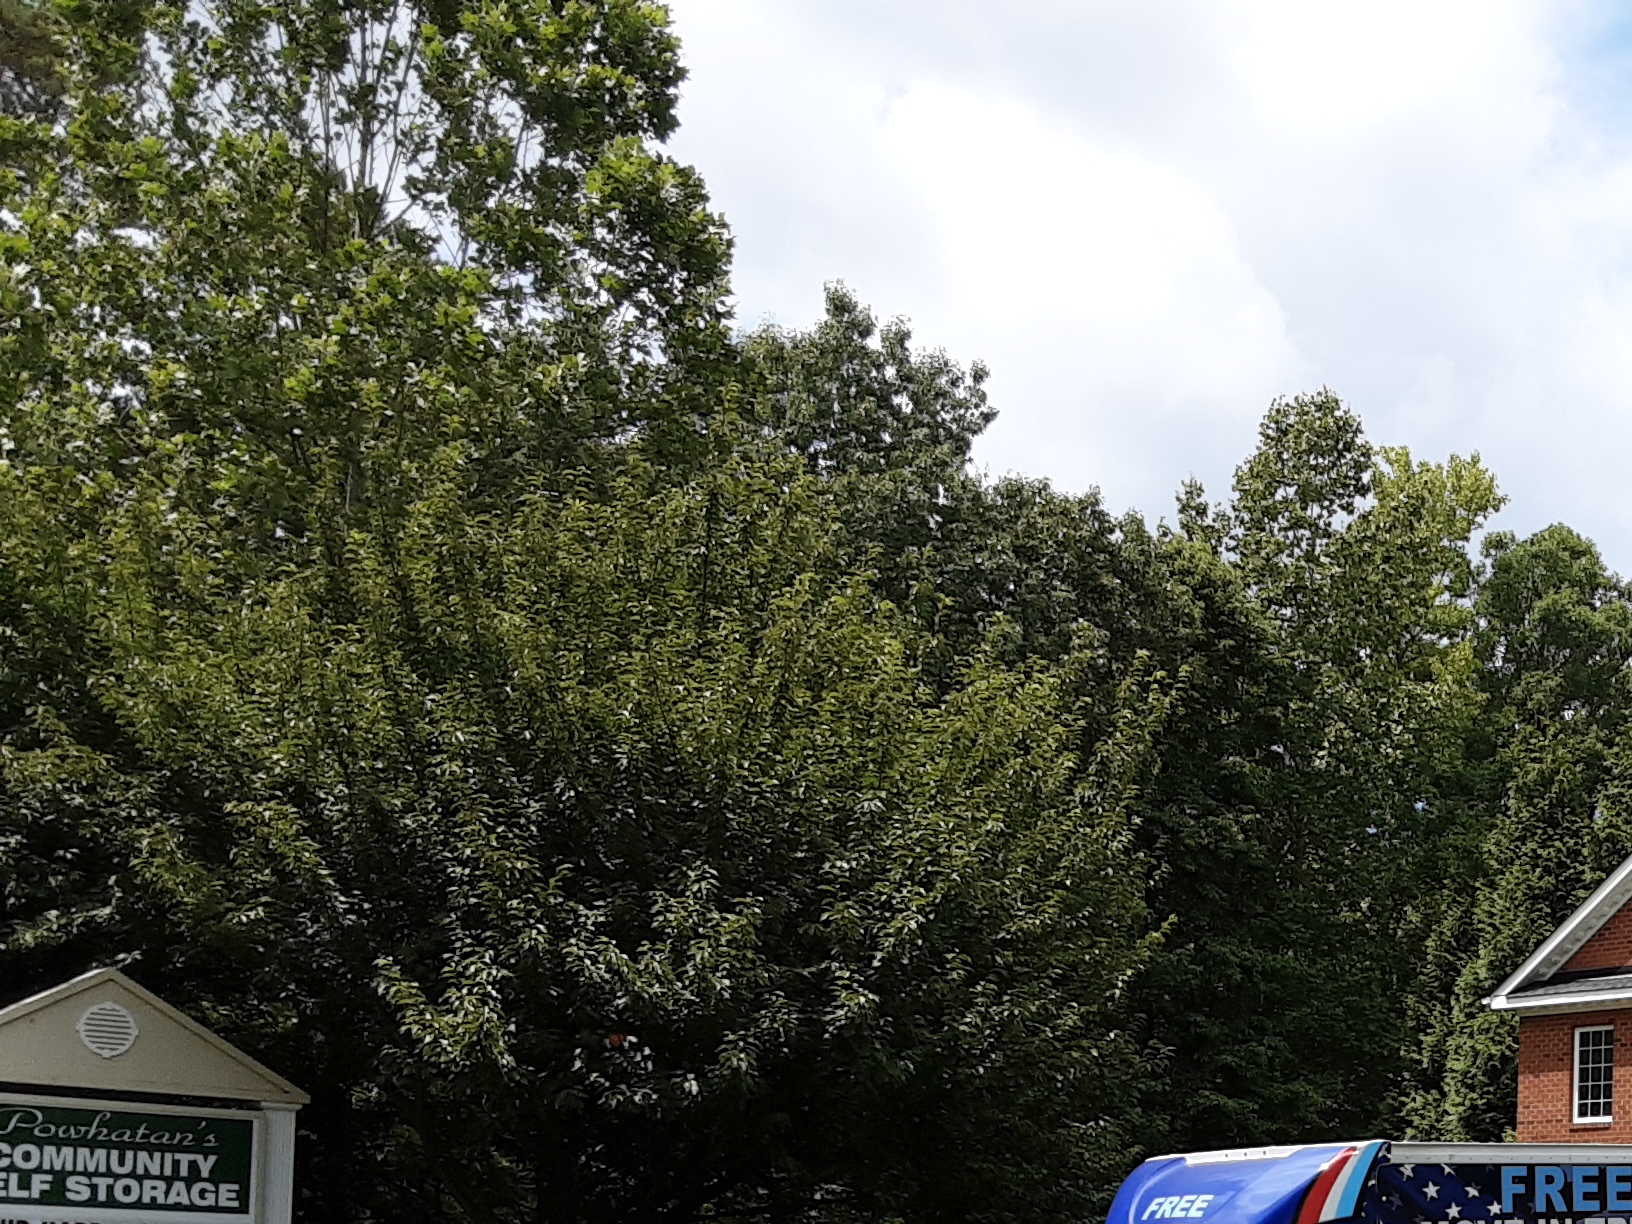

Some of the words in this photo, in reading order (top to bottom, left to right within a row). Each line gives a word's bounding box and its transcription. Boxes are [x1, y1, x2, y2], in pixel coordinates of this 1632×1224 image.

[0, 1107, 219, 1147] Powhatan's
[65, 1175, 240, 1208] STORAGE
[1141, 1194, 1214, 1220] FREE
